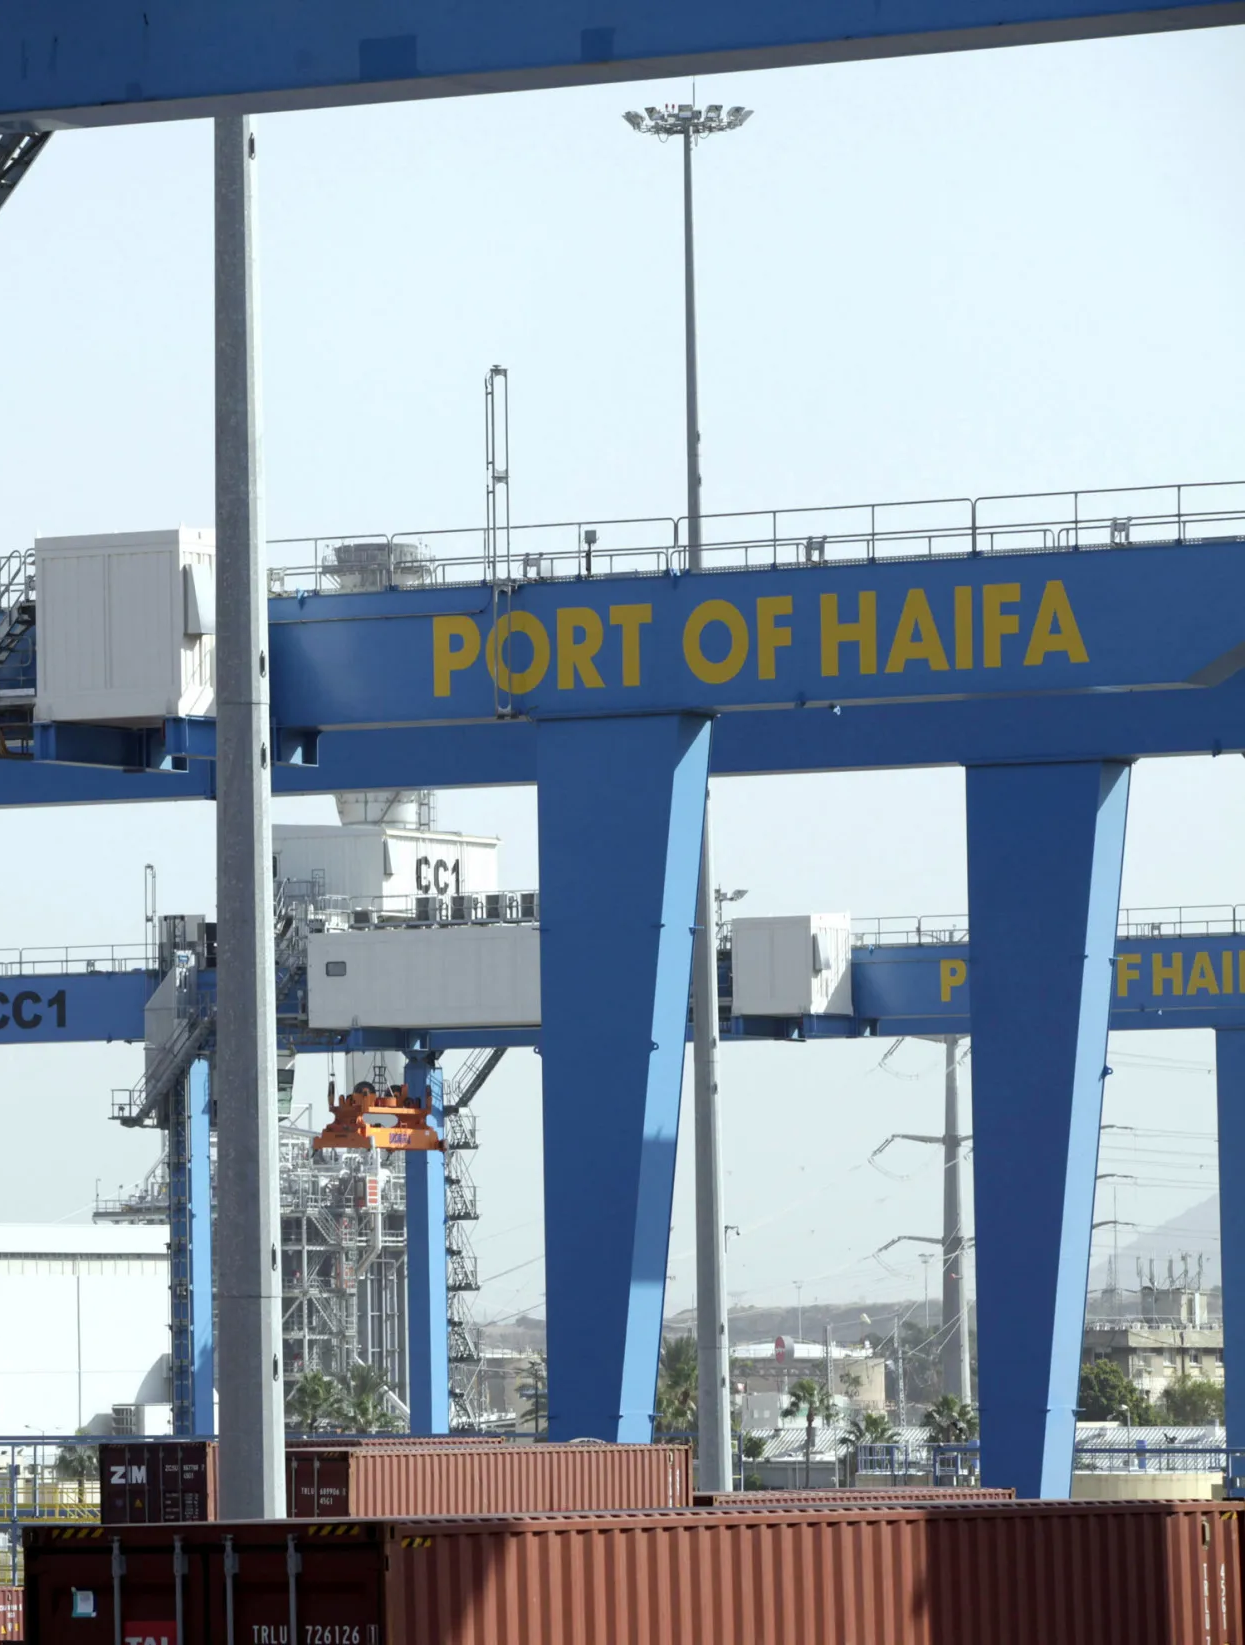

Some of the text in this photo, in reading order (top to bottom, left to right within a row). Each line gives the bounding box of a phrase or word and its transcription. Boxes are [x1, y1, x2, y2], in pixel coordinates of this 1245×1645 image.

[433, 580, 1089, 697] PORT OF HAIFA
[415, 856, 460, 896] CC1
[1151, 951, 1245, 996] HAI
[110, 1465, 146, 1484] ZIM
[252, 1625, 288, 1645] TRLU
[305, 1625, 361, 1645] 726126
